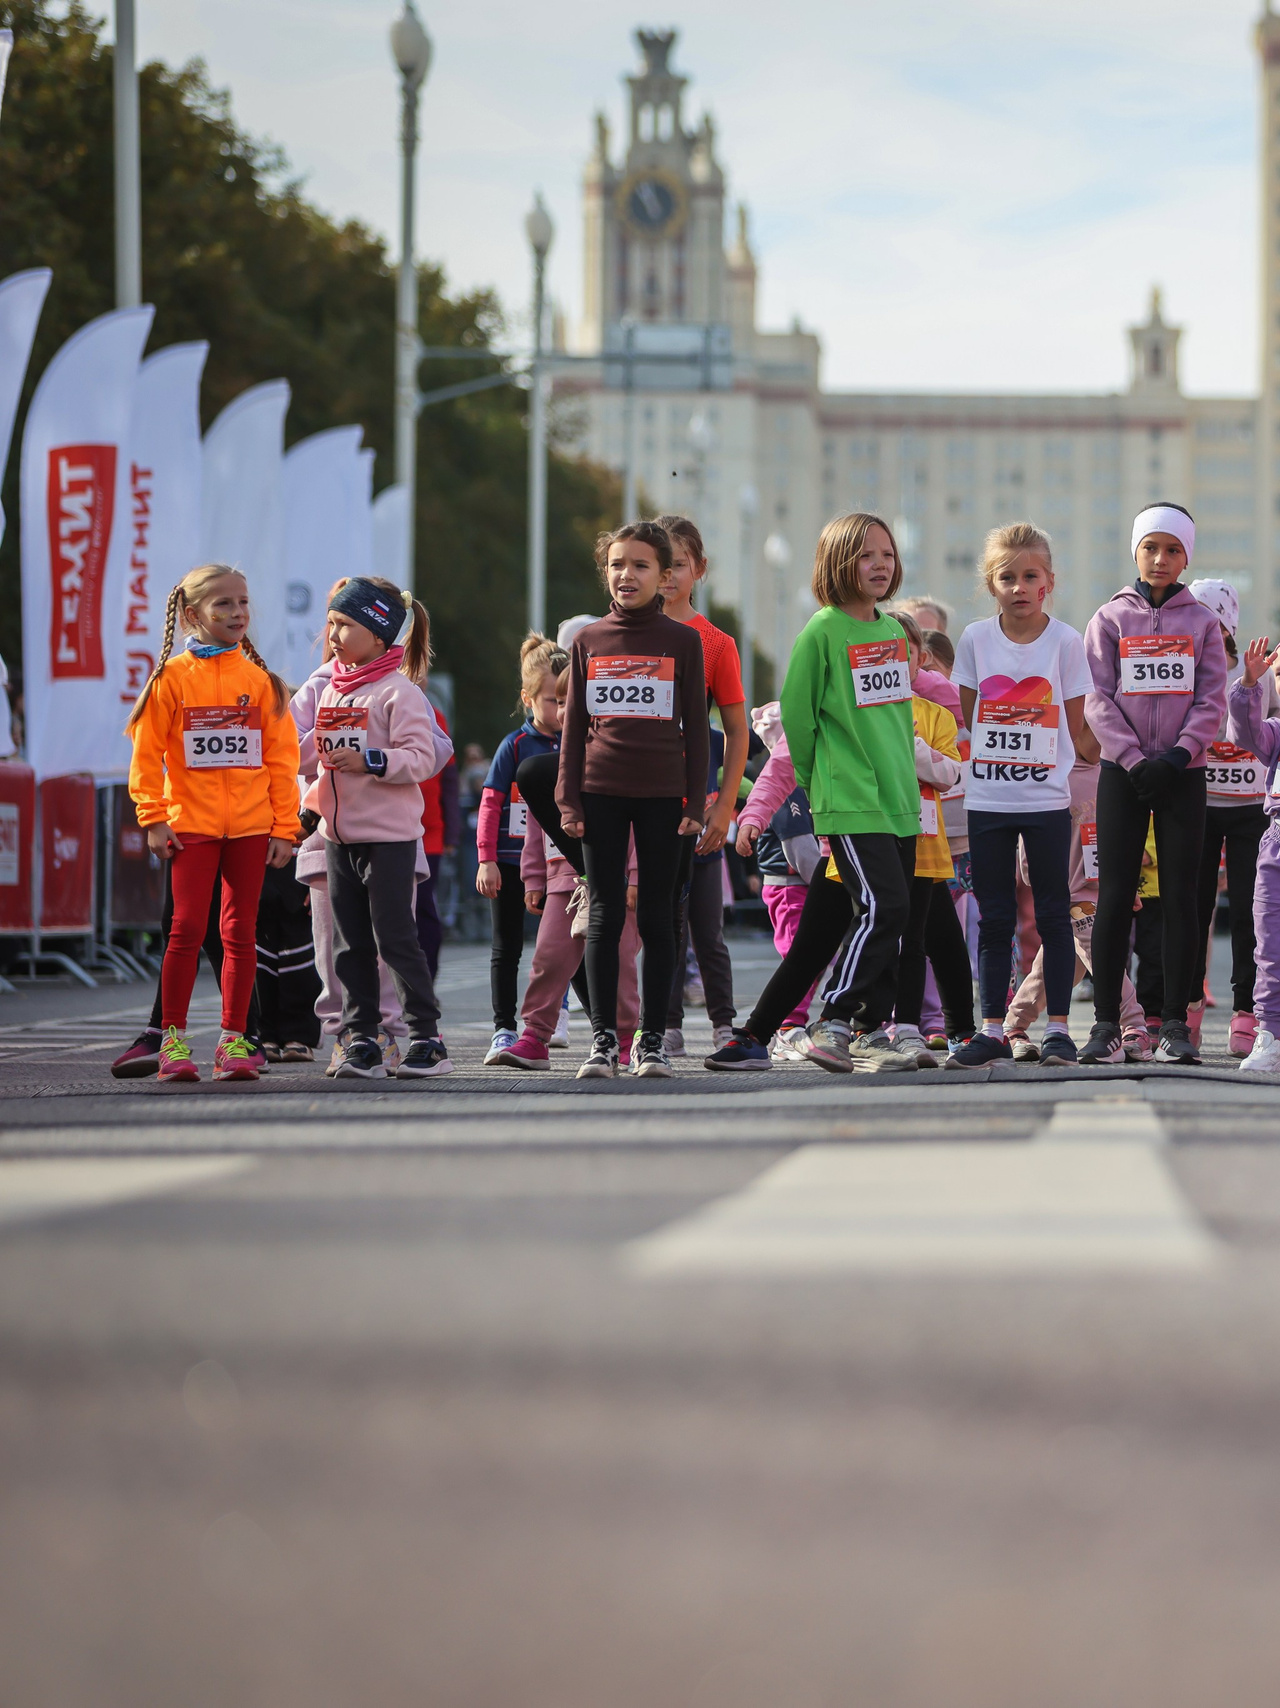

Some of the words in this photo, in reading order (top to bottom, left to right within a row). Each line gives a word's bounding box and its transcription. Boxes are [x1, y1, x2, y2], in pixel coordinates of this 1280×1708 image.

[127, 461, 153, 635] МАГНИТ
[860, 670, 901, 692] 3002
[1133, 663, 1185, 680] 3168
[595, 685, 655, 704] 3028
[193, 736, 248, 755] 3052
[985, 731, 1031, 751] 3131
[1205, 768, 1256, 784] 3350
[1075, 914, 1096, 928] JER
